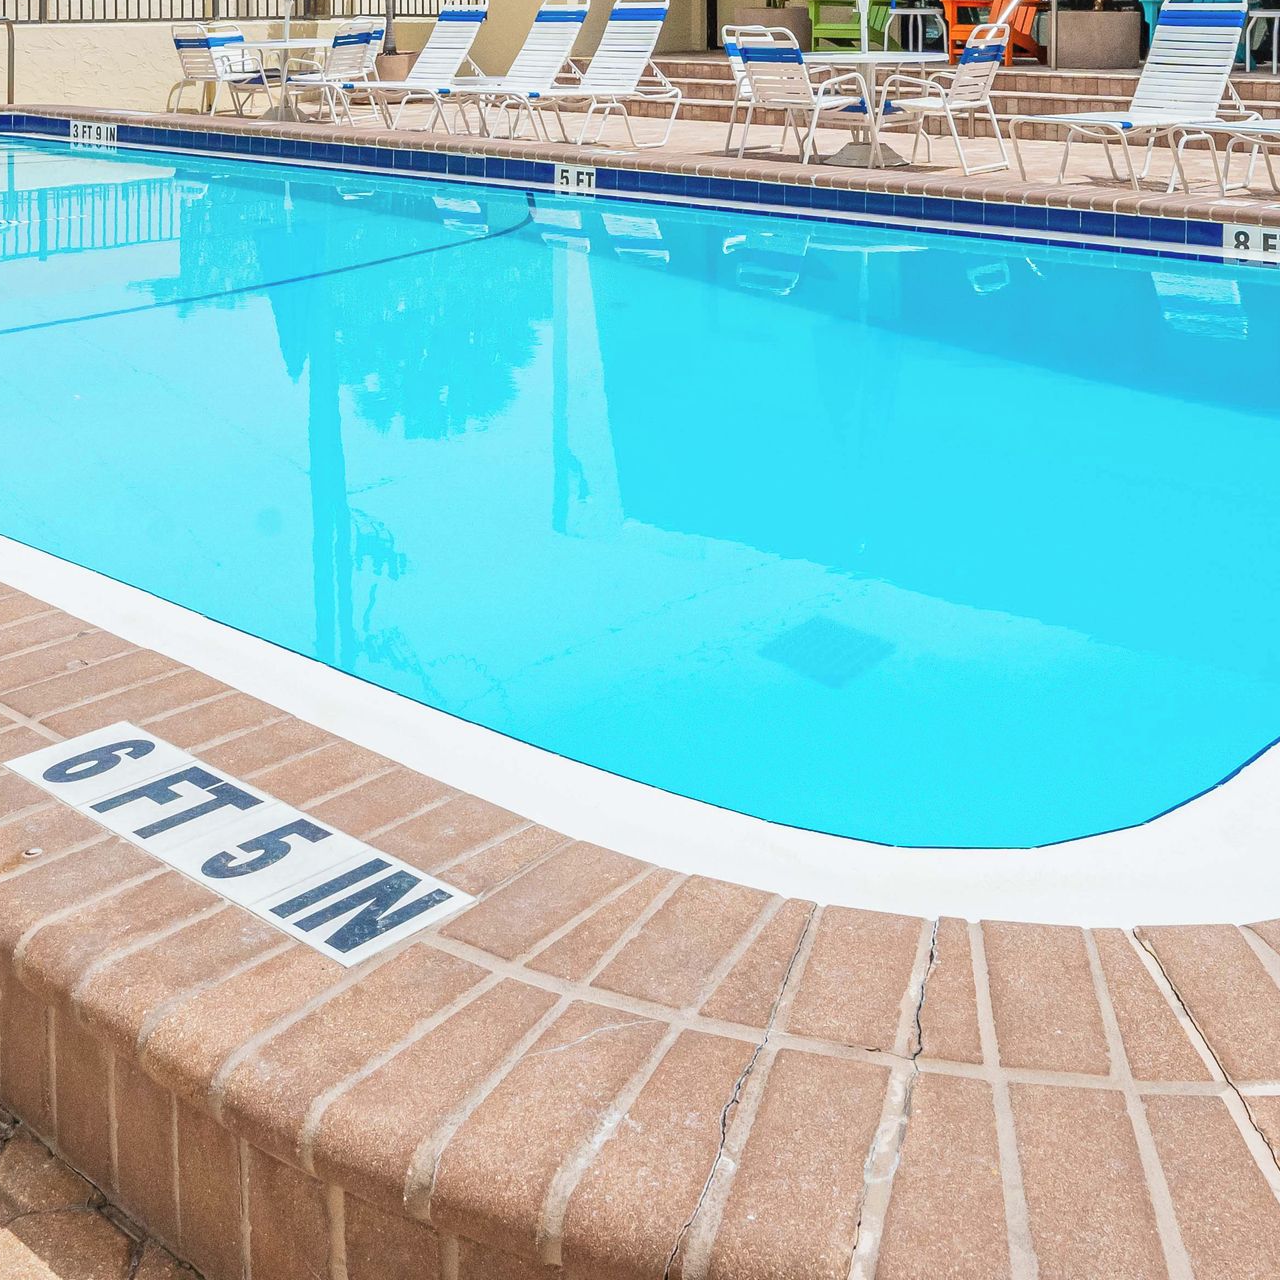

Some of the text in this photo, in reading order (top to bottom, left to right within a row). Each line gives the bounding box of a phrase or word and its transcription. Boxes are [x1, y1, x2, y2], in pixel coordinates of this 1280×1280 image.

[73, 124, 115, 142] 3 FT 9 IN
[560, 169, 594, 188] 5 FT
[1234, 230, 1250, 250] 8
[42, 738, 455, 954] 6 FT 5 IN
